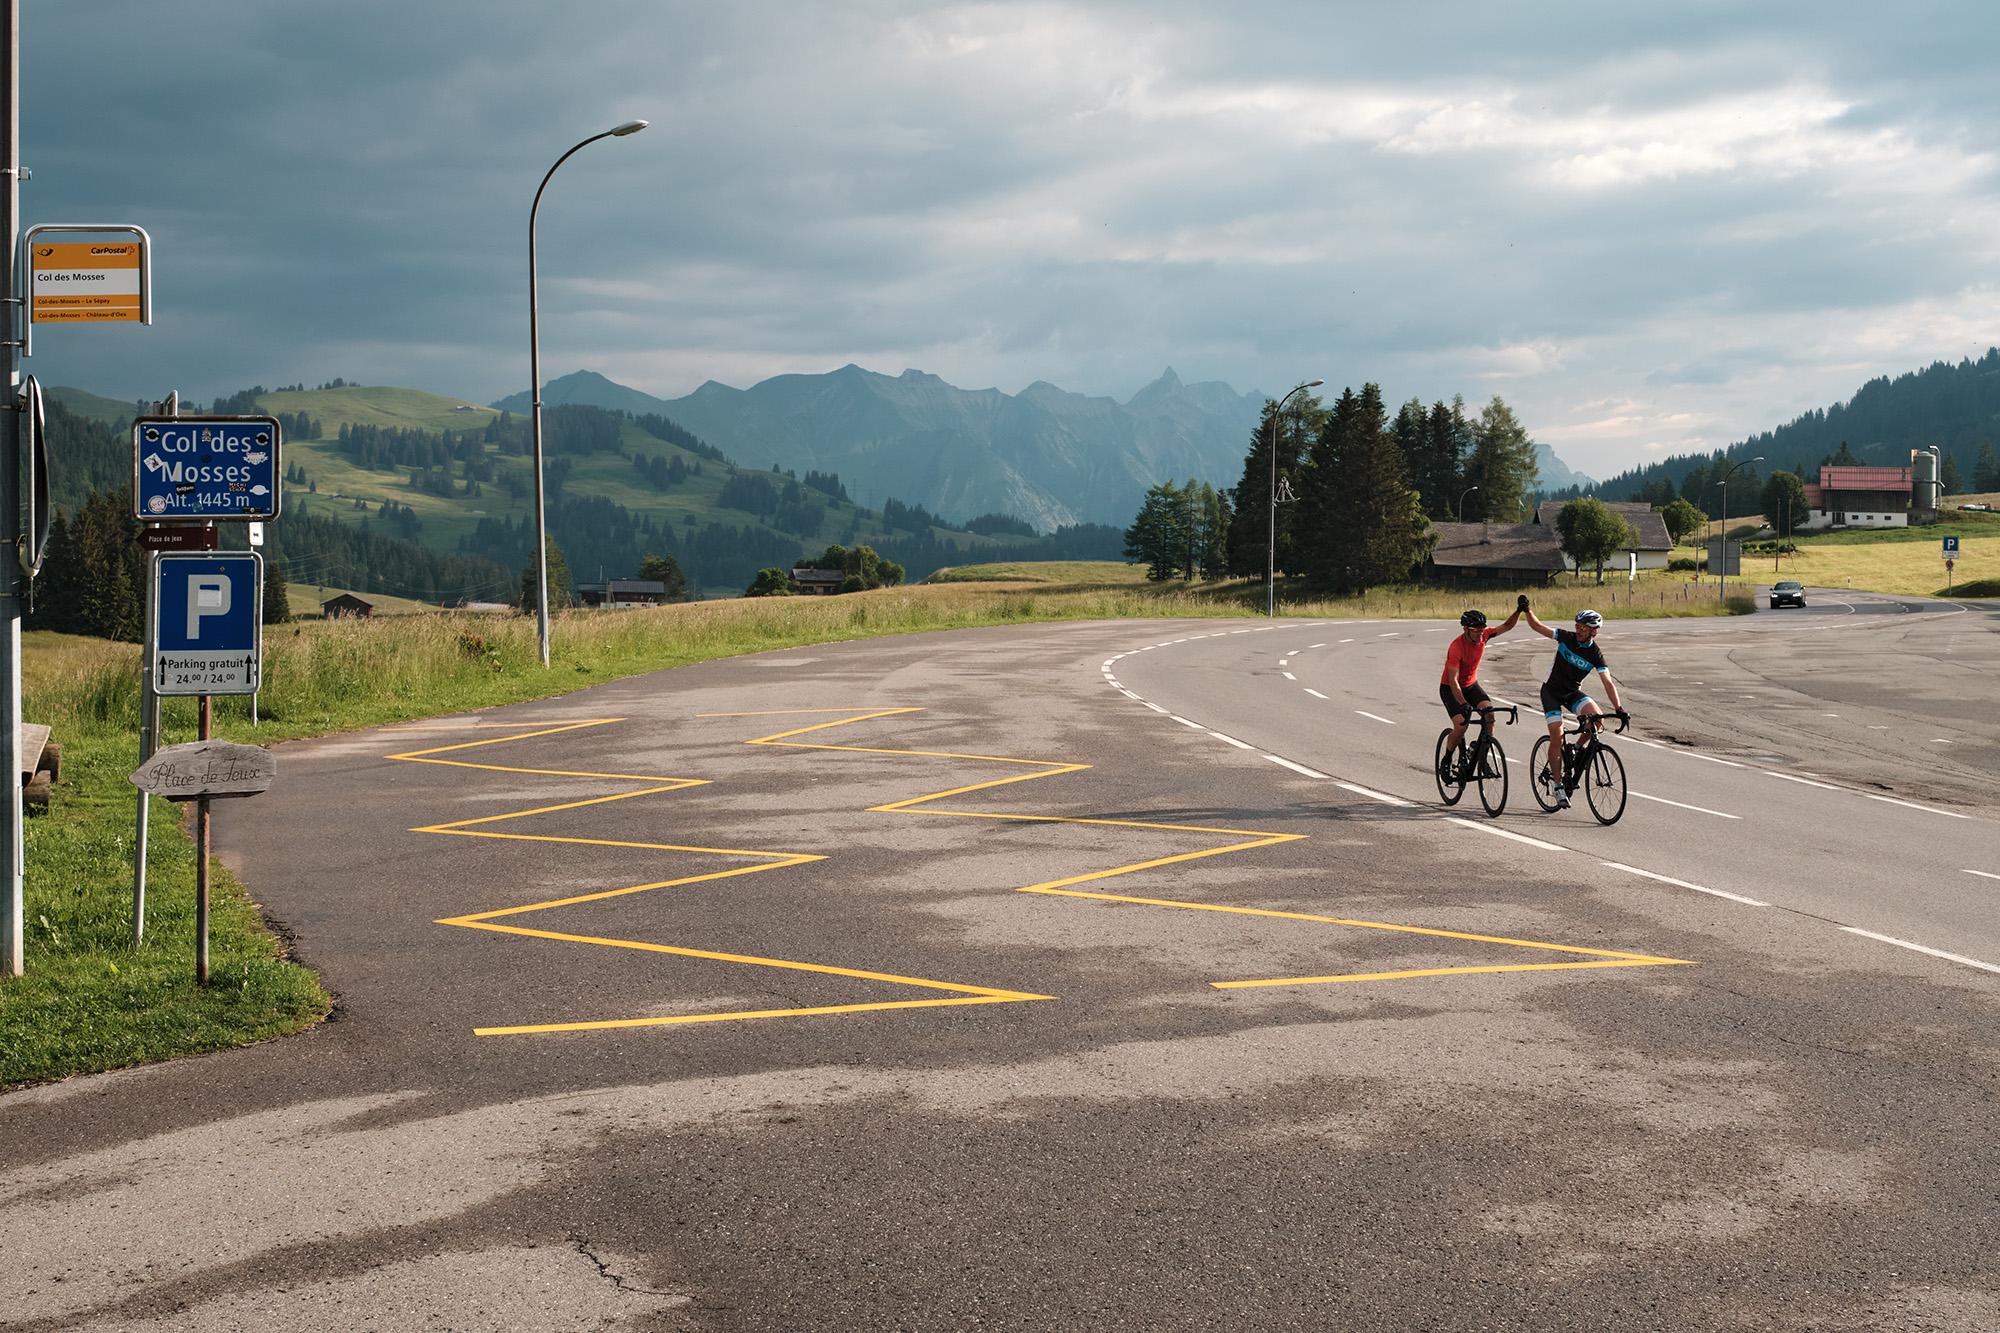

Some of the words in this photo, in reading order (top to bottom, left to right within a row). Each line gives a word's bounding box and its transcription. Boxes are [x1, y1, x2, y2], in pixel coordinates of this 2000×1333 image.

[91, 247, 127, 255] CarPostal
[161, 430, 197, 453] Col
[210, 430, 252, 453] des
[161, 461, 251, 483] Mosses
[196, 492, 231, 507] 1445
[236, 496, 250, 507] m
[1948, 539, 1954, 550] P
[187, 574, 232, 640] P
[168, 659, 206, 670] Parking
[210, 659, 244, 670] gratuit
[147, 760, 195, 790] Place
[200, 760, 218, 784] de
[220, 758, 260, 782] Jeux
